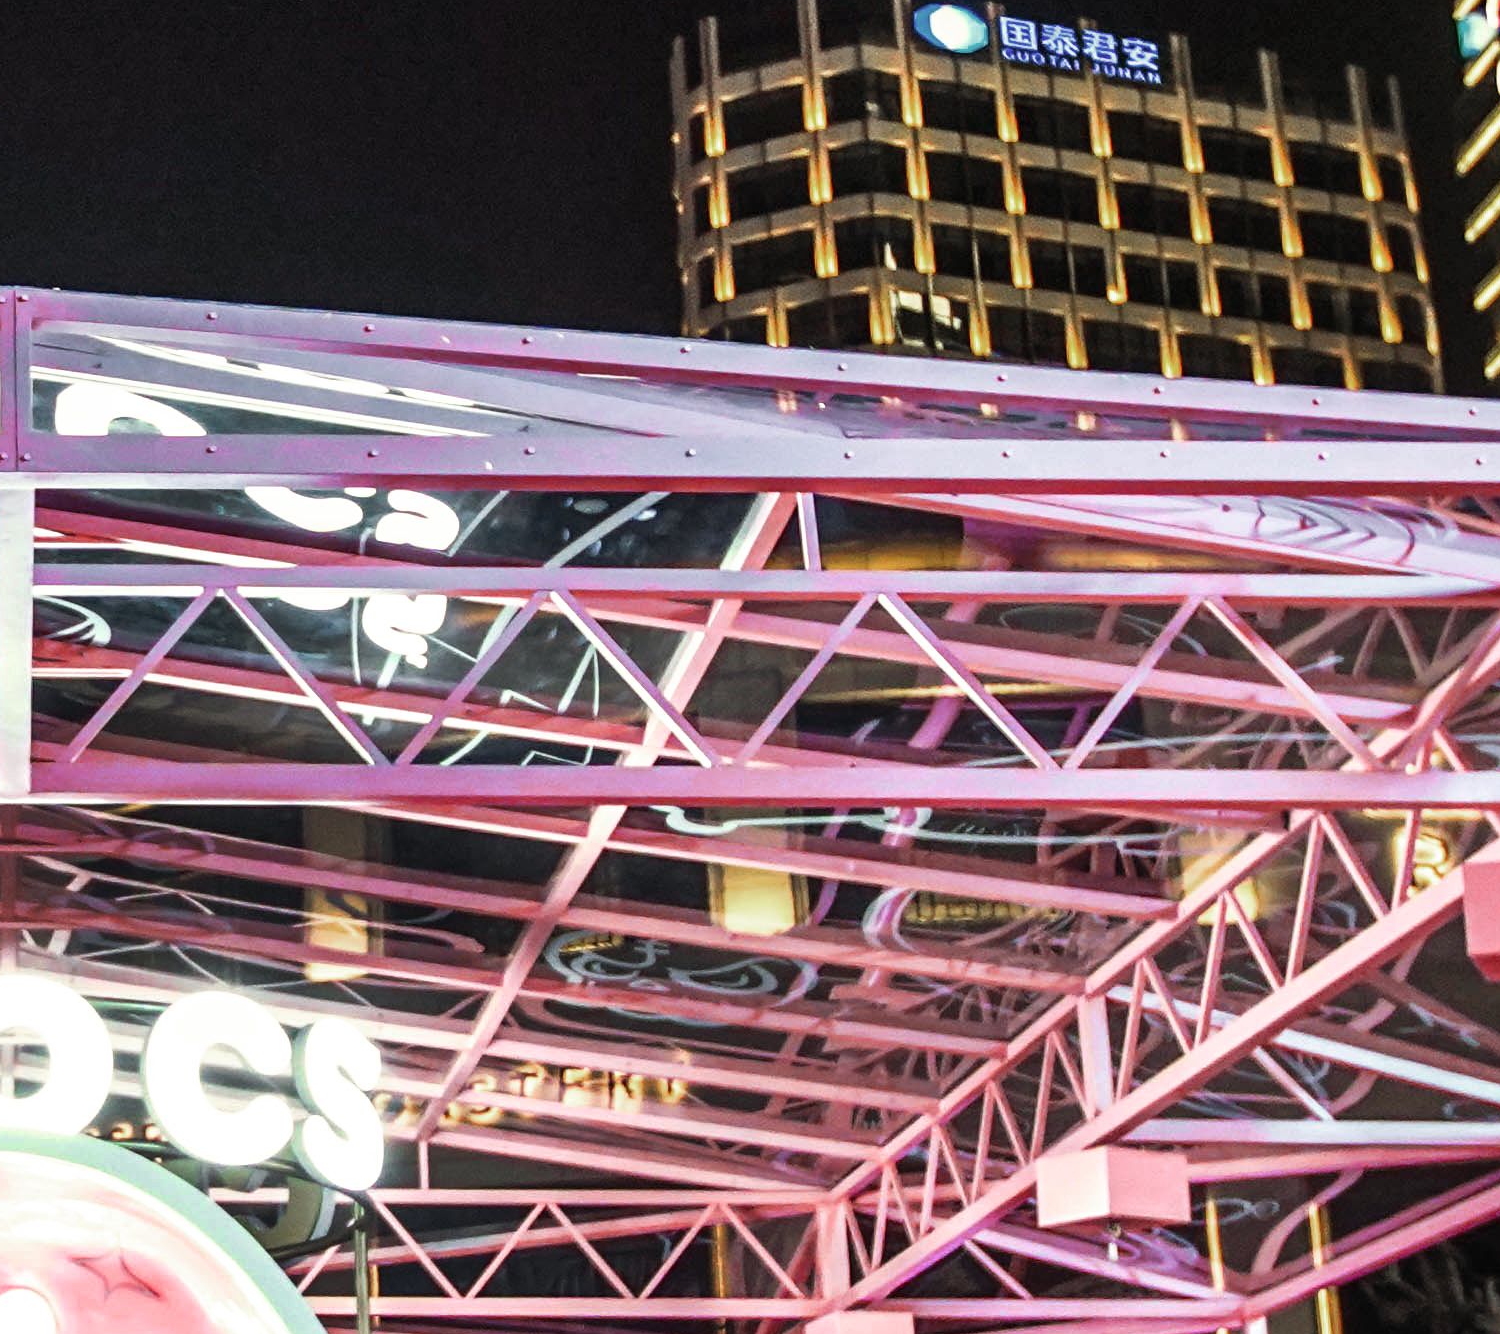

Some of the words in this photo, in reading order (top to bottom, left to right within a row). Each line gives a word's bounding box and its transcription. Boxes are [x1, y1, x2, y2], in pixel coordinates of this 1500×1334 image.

[1000, 16, 1159, 70] 国泰君安
[1002, 47, 1080, 71] GUOTAI
[1092, 63, 1162, 84] JUNAN
